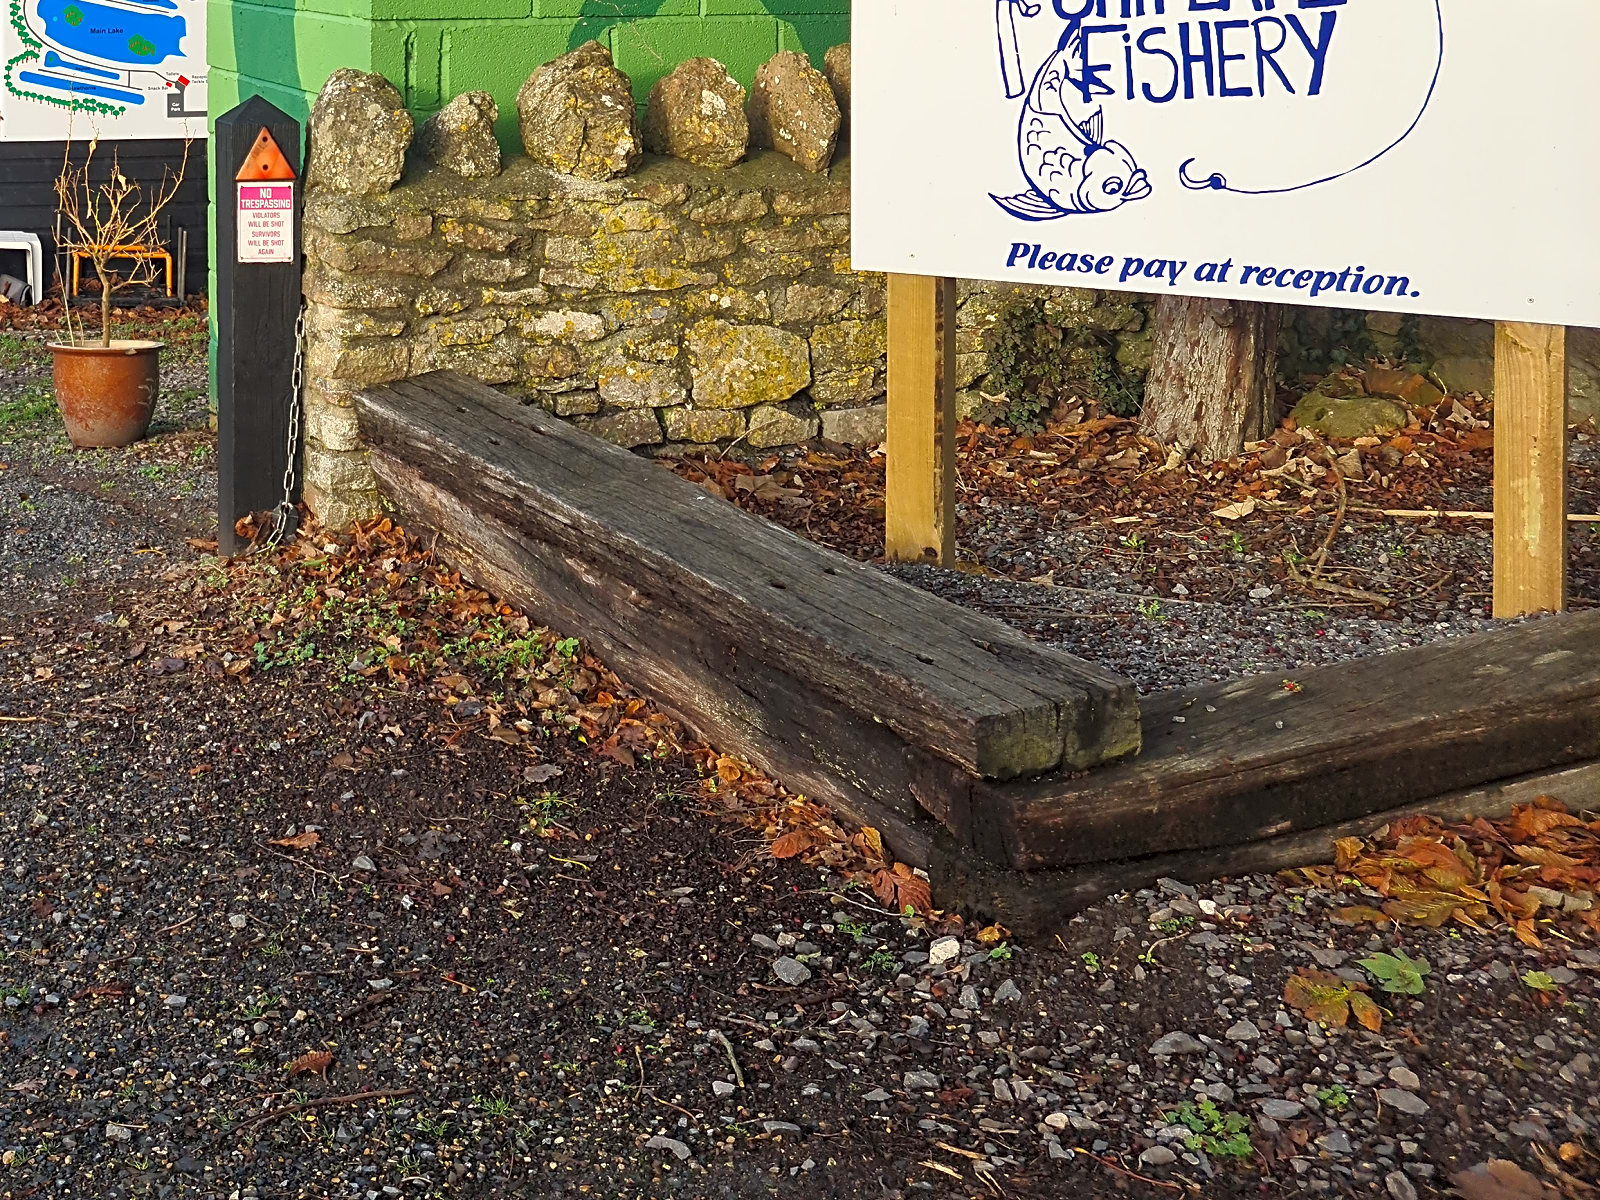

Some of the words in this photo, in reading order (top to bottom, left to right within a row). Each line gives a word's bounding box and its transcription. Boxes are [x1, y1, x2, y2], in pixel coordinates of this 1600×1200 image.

[260, 188, 272, 199] NO
[241, 199, 291, 209] TRESPASSING
[1006, 242, 1114, 275] Please
[1120, 255, 1186, 286] pay
[1195, 256, 1234, 283] at
[1239, 264, 1421, 298] reception.
